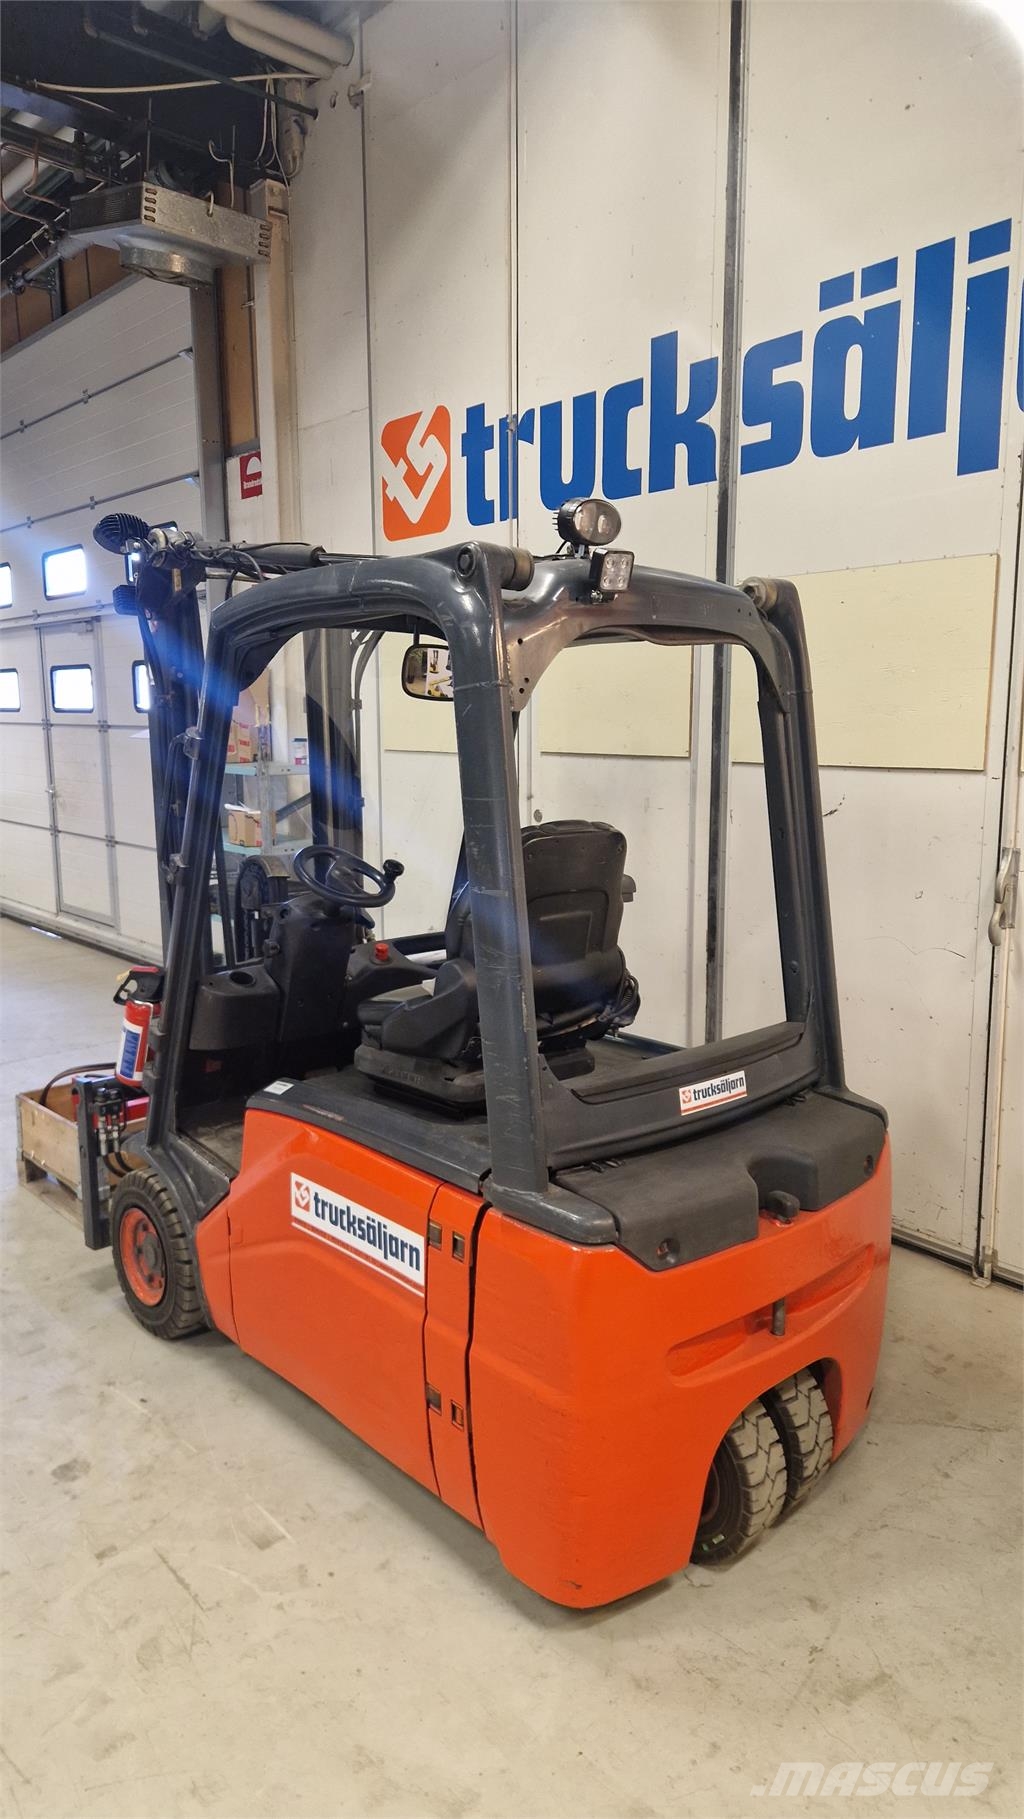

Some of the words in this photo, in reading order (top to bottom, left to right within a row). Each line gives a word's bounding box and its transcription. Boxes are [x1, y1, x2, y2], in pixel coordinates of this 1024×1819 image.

[461, 217, 1024, 526] trucksälj
[693, 1077, 745, 1101] trucksäljarn
[313, 1191, 421, 1272] trucksäljarn
